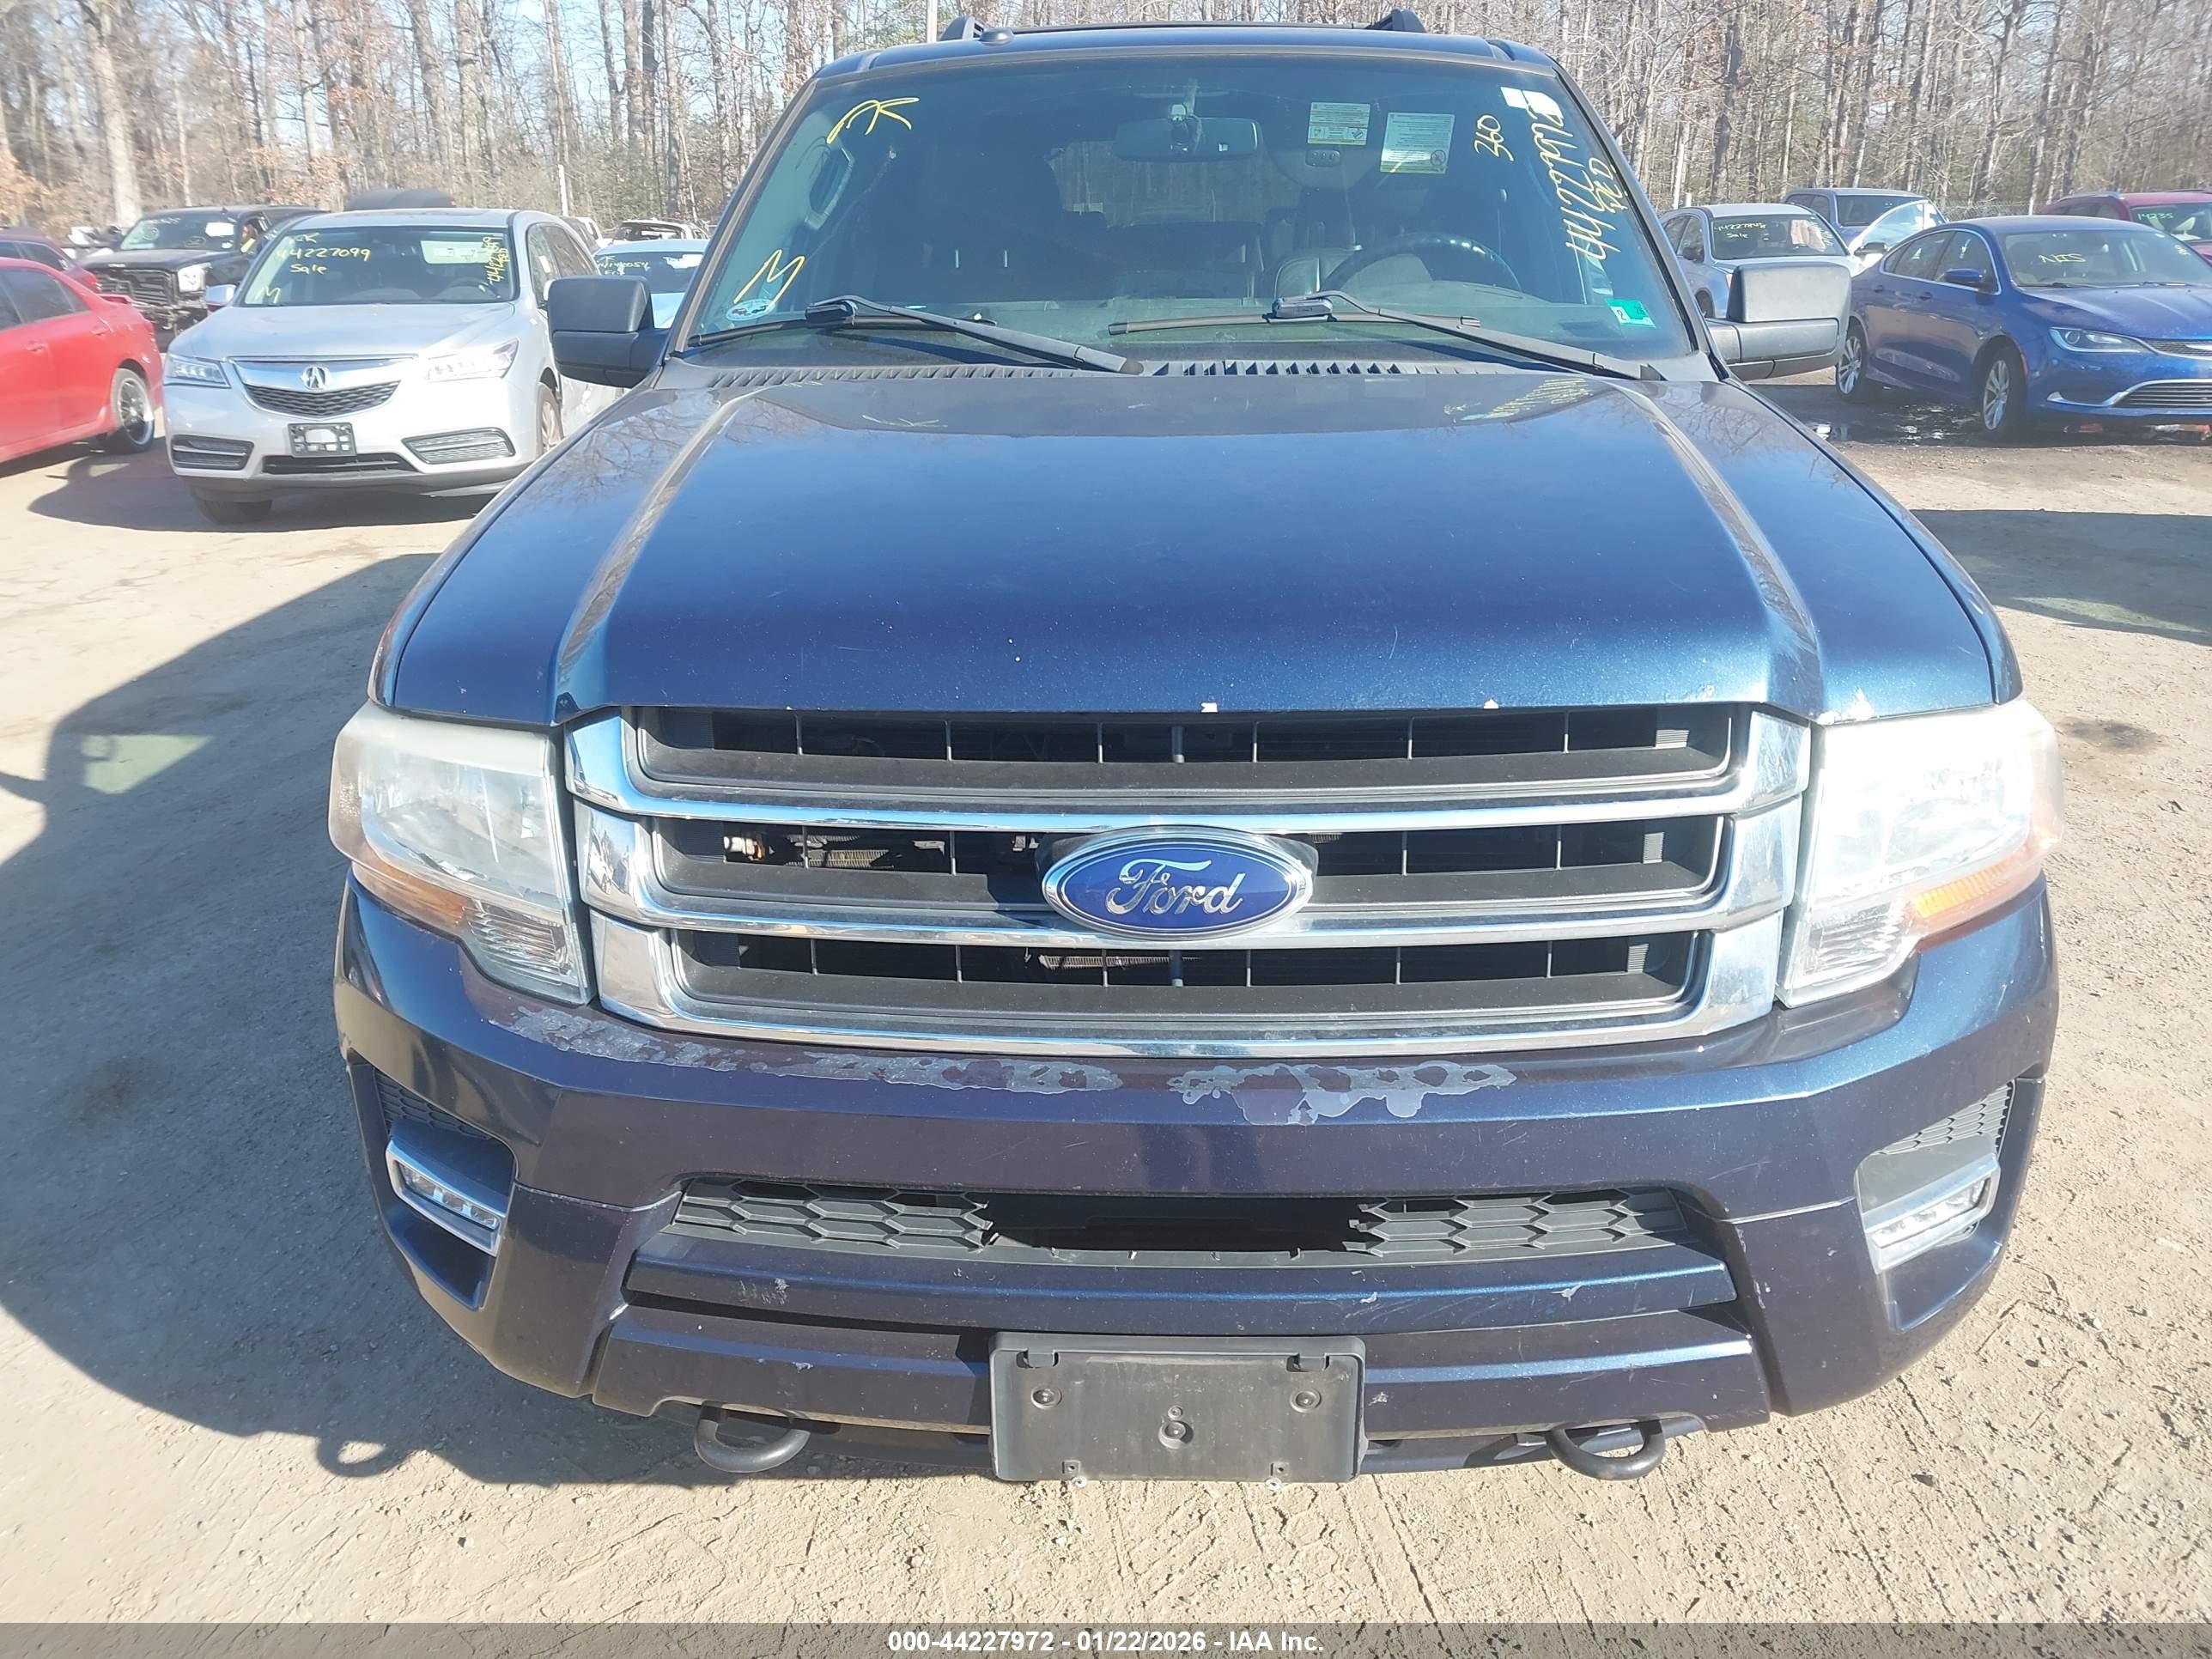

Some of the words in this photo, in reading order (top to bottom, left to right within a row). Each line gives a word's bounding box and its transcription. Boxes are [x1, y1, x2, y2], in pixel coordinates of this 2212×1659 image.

[1474, 114, 1515, 162] 360
[276, 246, 372, 262] 44227099
[289, 263, 327, 275] Sale
[733, 249, 805, 312] M
[1106, 858, 1246, 915] Ford
